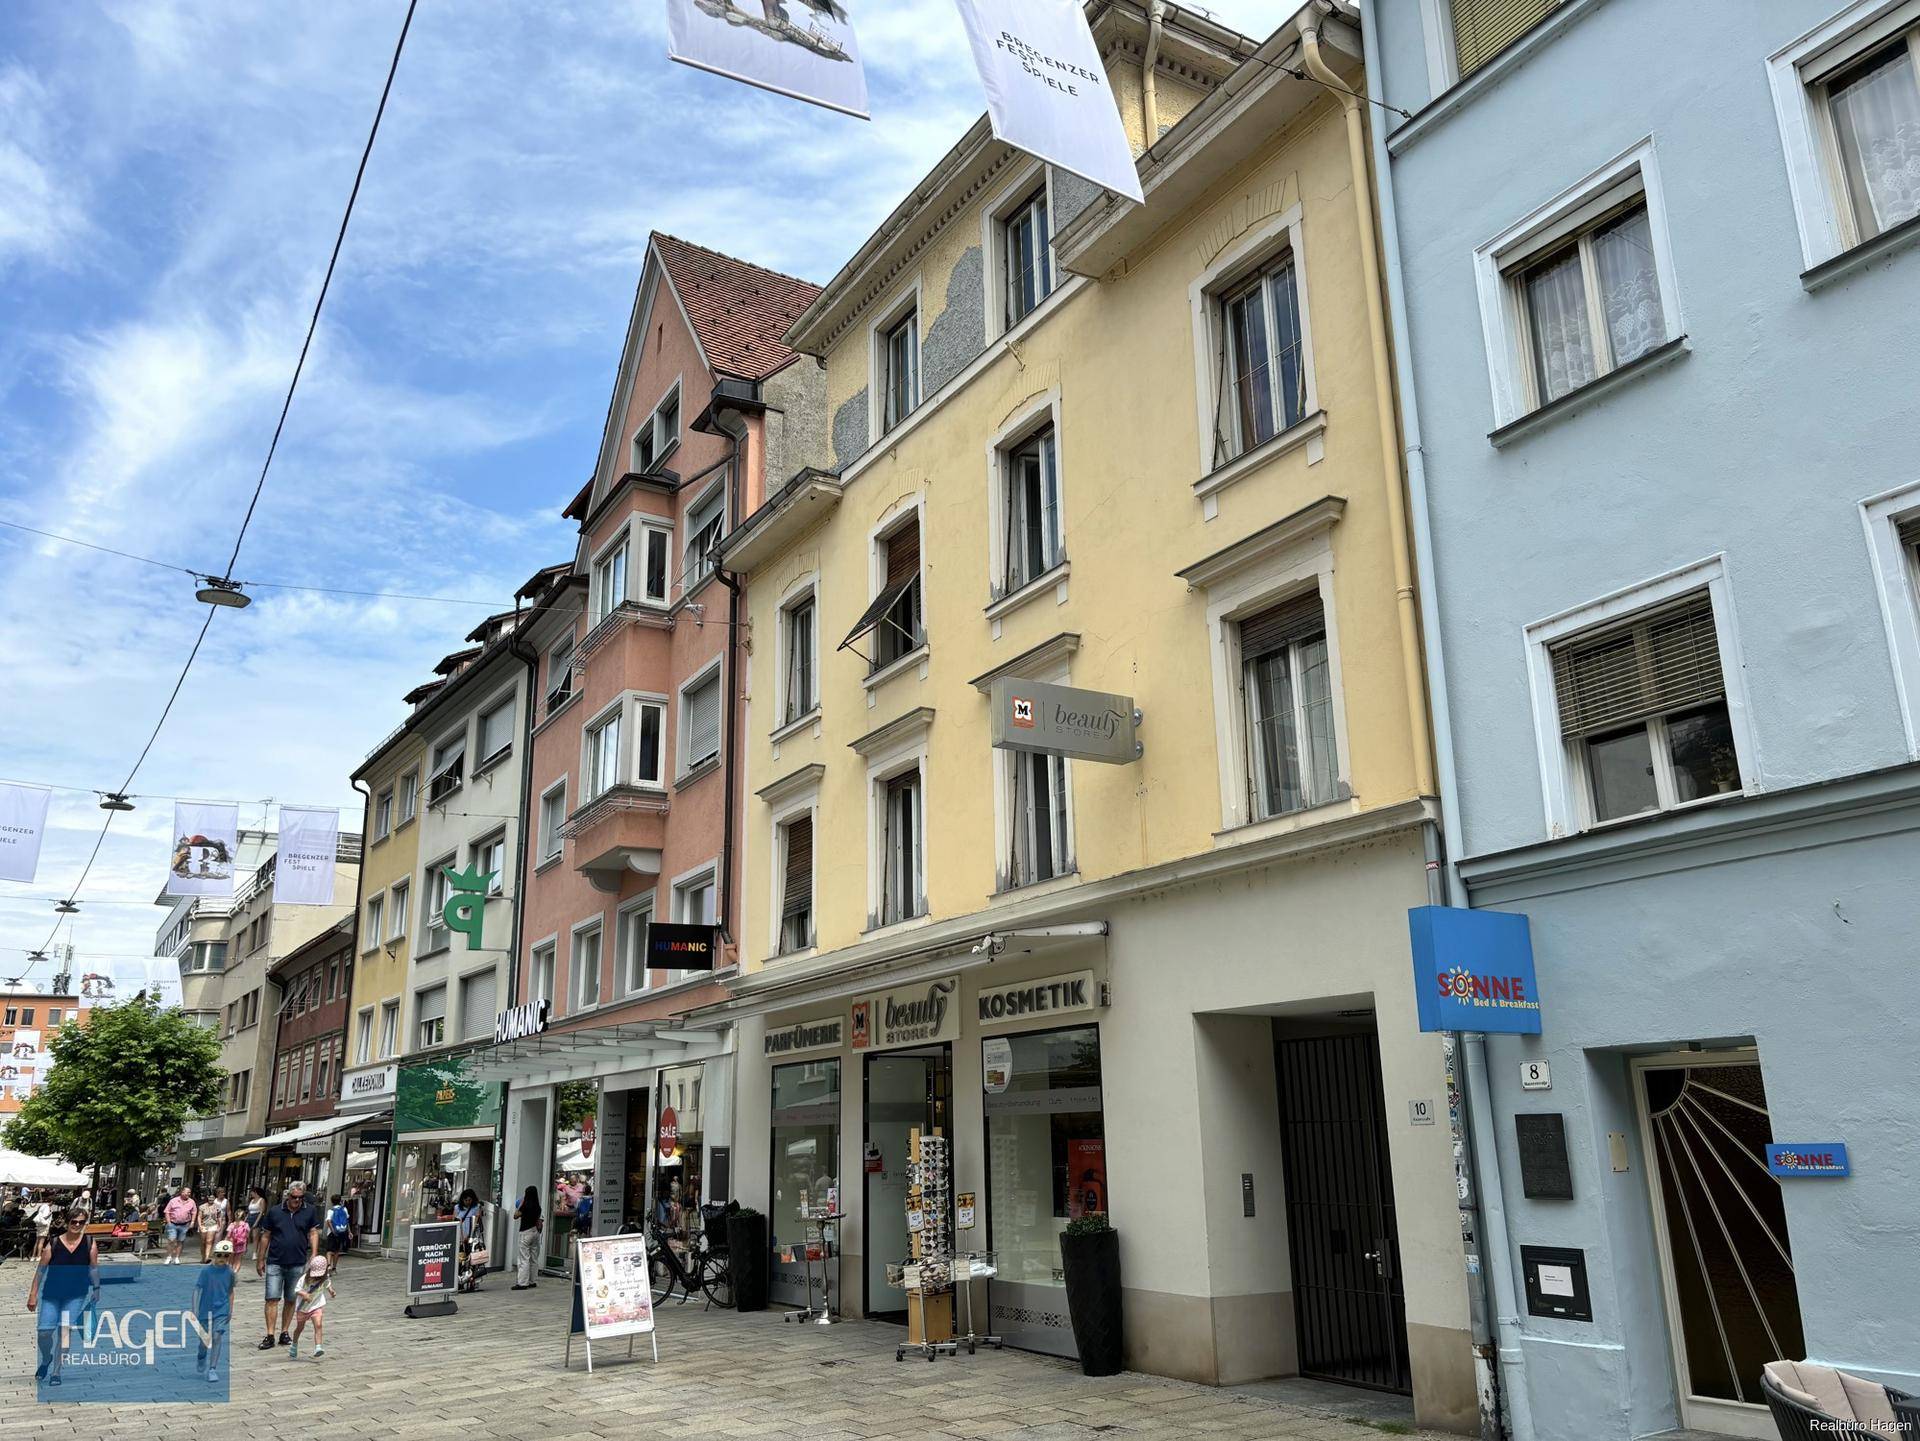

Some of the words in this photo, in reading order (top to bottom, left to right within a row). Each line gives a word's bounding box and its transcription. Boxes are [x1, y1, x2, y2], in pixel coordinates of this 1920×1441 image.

[996, 39, 1034, 65] FEST
[1002, 31, 1099, 84] BREGENZER
[1022, 62, 1078, 96] SPIELE
[1017, 704, 1029, 715] M
[1055, 704, 1127, 739] beauty
[1055, 725, 1101, 738] STORE
[655, 941, 707, 952] HUMANIC
[1438, 972, 1525, 1001] SONNE
[979, 979, 1087, 1020] KOSMETIK
[1473, 997, 1490, 1007] Bed
[1491, 999, 1498, 1008] &
[1499, 999, 1540, 1009] Breakfast
[885, 979, 956, 1038] beauty
[494, 999, 548, 1044] HUMANIC
[855, 1013, 865, 1029] M
[765, 1023, 841, 1056] PARFÜMERIE
[886, 1026, 929, 1043] STORE
[1529, 1063, 1540, 1080] 8
[1414, 1102, 1427, 1116] 10
[581, 1127, 595, 1142] SALE
[660, 1123, 677, 1138] SALE
[1774, 1153, 1834, 1167] SONNE
[417, 1243, 452, 1252] VERRÜCKT
[425, 1250, 443, 1258] NACH
[418, 1257, 450, 1266] SCHUHEN
